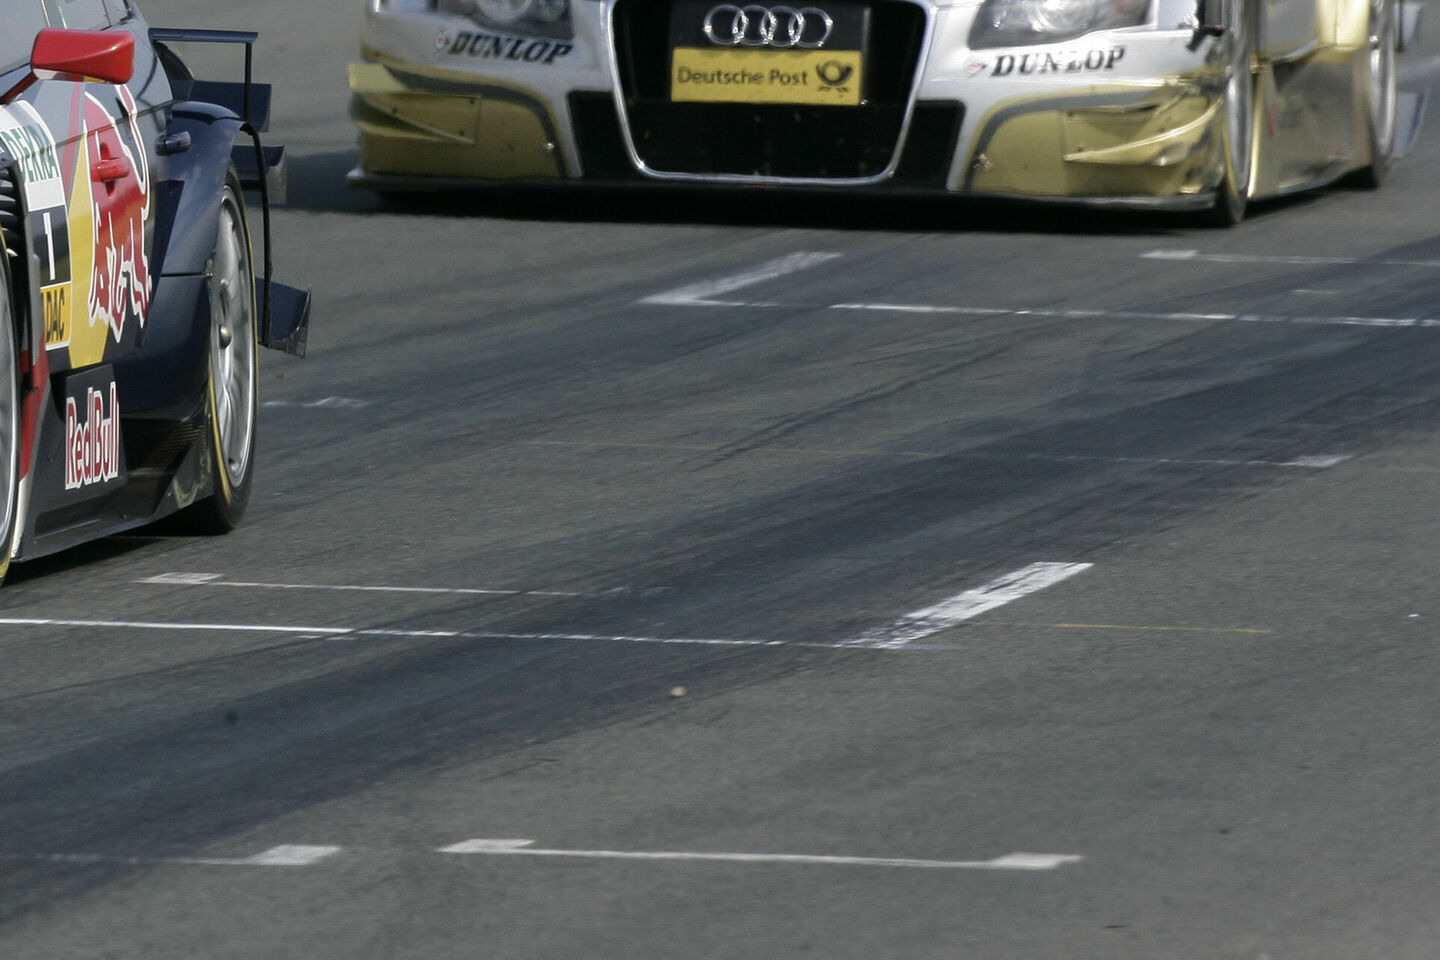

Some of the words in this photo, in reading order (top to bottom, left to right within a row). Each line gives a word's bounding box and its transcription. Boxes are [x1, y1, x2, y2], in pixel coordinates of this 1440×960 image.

[447, 32, 574, 65] DUNLOP
[991, 48, 1126, 76] DUNLOP
[678, 66, 763, 85] Deutsche
[769, 68, 809, 86] Post
[43, 212, 56, 280] 1
[65, 386, 93, 490] Red
[92, 380, 119, 483] Bull
